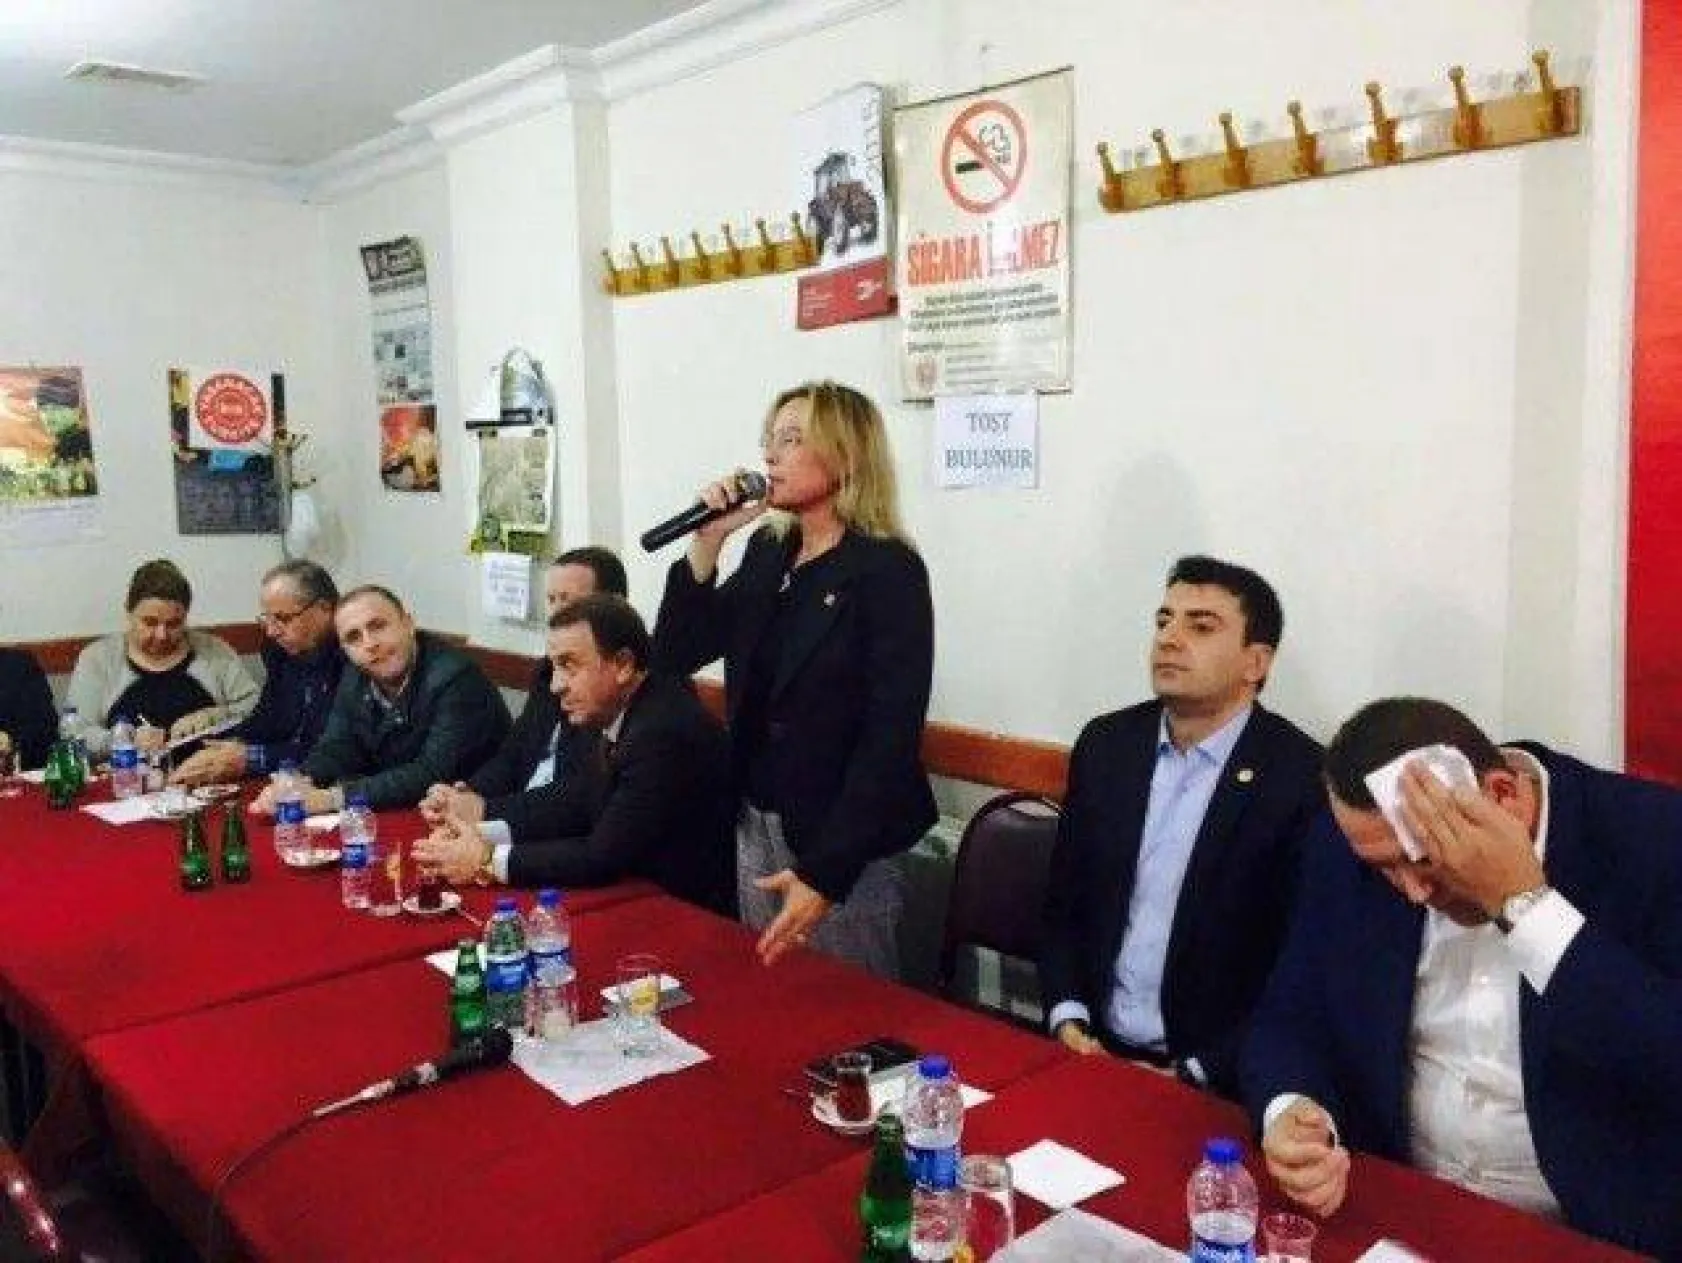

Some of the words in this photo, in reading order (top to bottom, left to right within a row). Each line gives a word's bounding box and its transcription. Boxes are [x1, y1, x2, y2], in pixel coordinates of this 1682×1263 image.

[907, 232, 983, 287] SİGARA
[965, 412, 1012, 432] TOST
[946, 448, 1033, 471] BULUNUR
